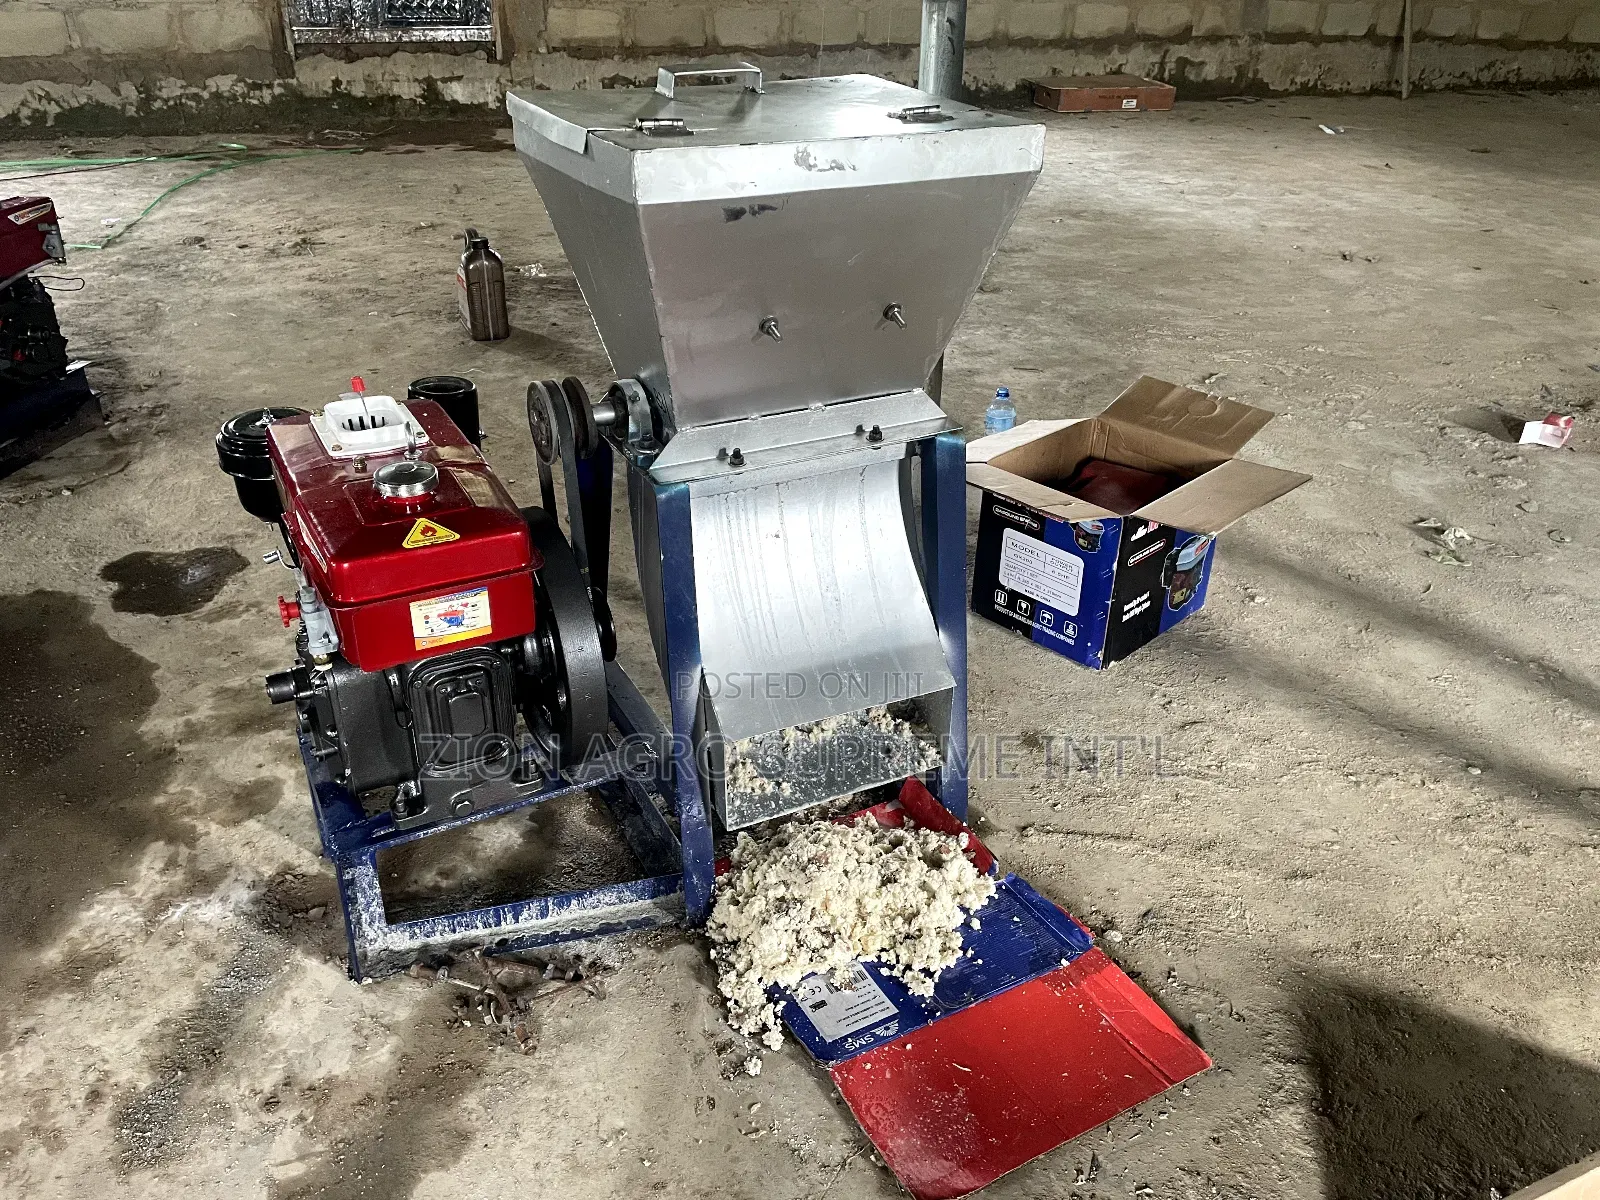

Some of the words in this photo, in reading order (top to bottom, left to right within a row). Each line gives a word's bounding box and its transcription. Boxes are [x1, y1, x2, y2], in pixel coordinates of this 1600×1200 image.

[1011, 541, 1041, 558] MODEL
[1050, 560, 1073, 573] OUTPUT
[1051, 557, 1073, 569] POWER
[844, 1034, 875, 1051] SMS
